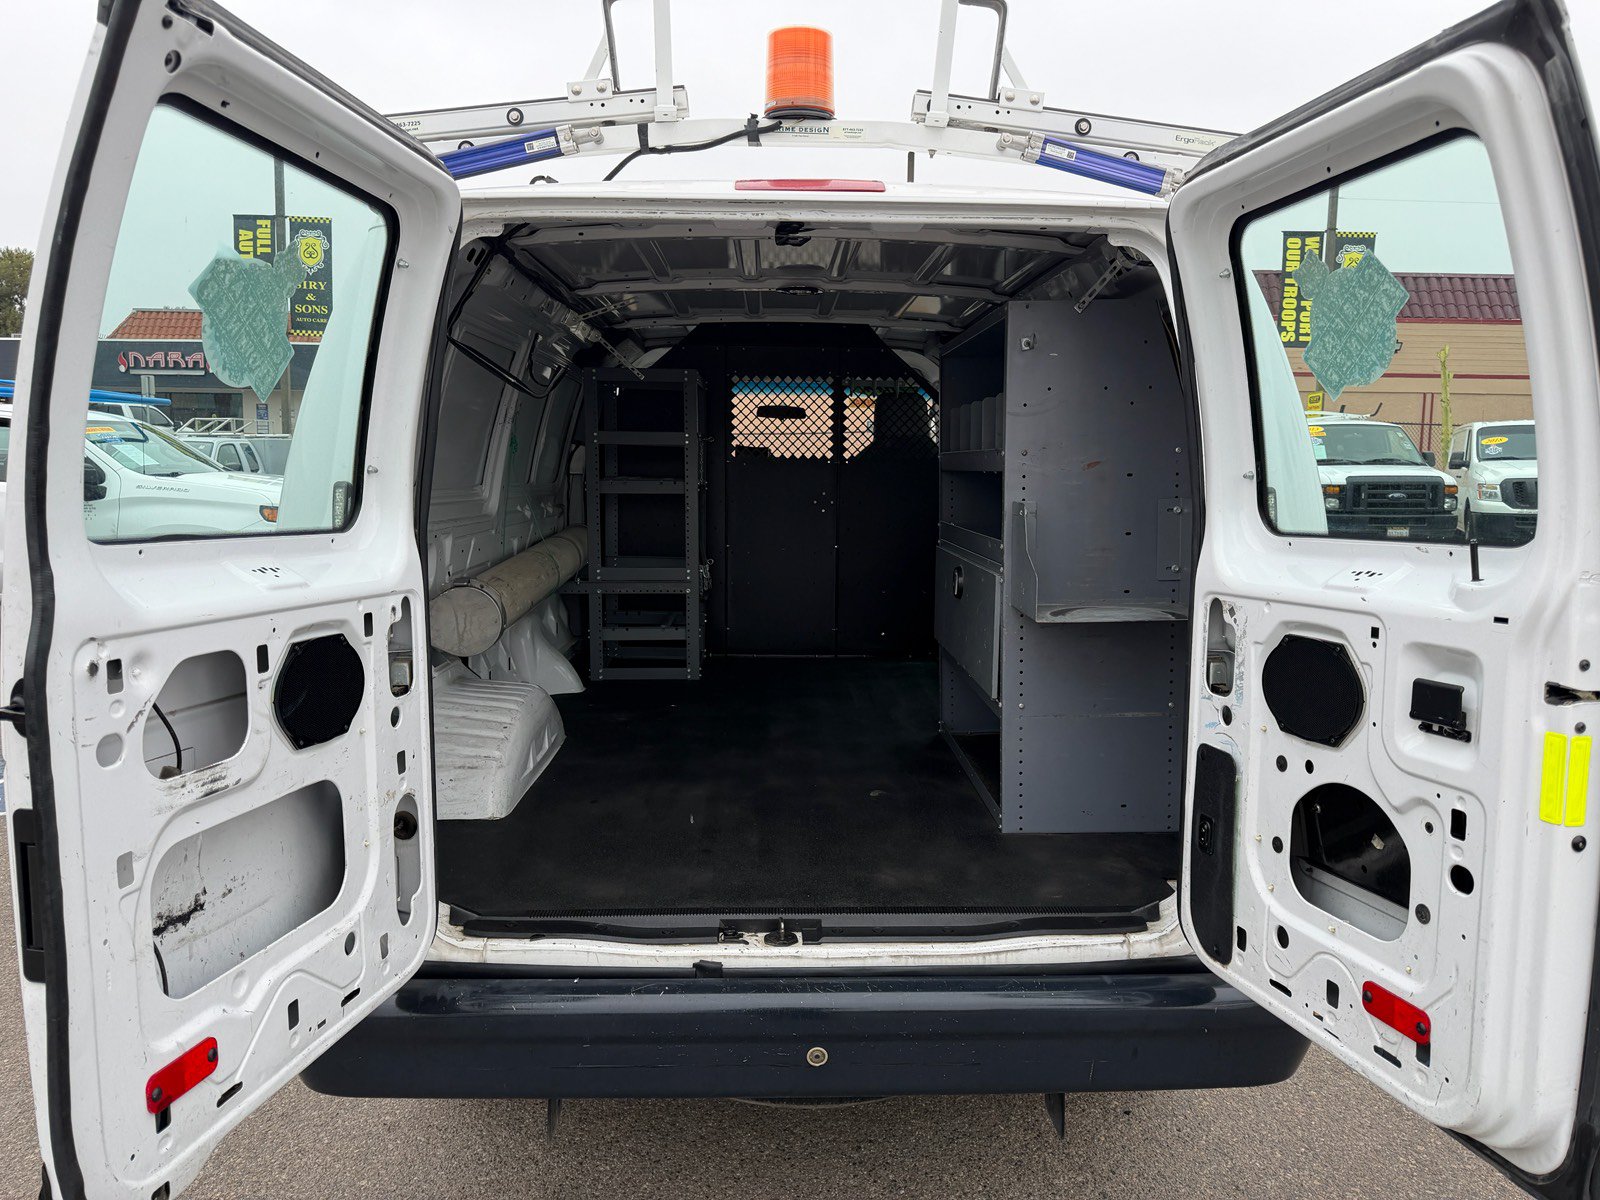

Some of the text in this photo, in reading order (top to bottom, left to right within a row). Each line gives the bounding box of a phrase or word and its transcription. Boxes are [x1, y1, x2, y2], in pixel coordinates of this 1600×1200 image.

[256, 219, 272, 256] FULL
[305, 293, 316, 301] &
[1280, 237, 1302, 343] OUR TROOPS
[294, 303, 328, 315] SONS
[128, 351, 205, 368] NARA
[135, 484, 191, 493] SILVERADO
